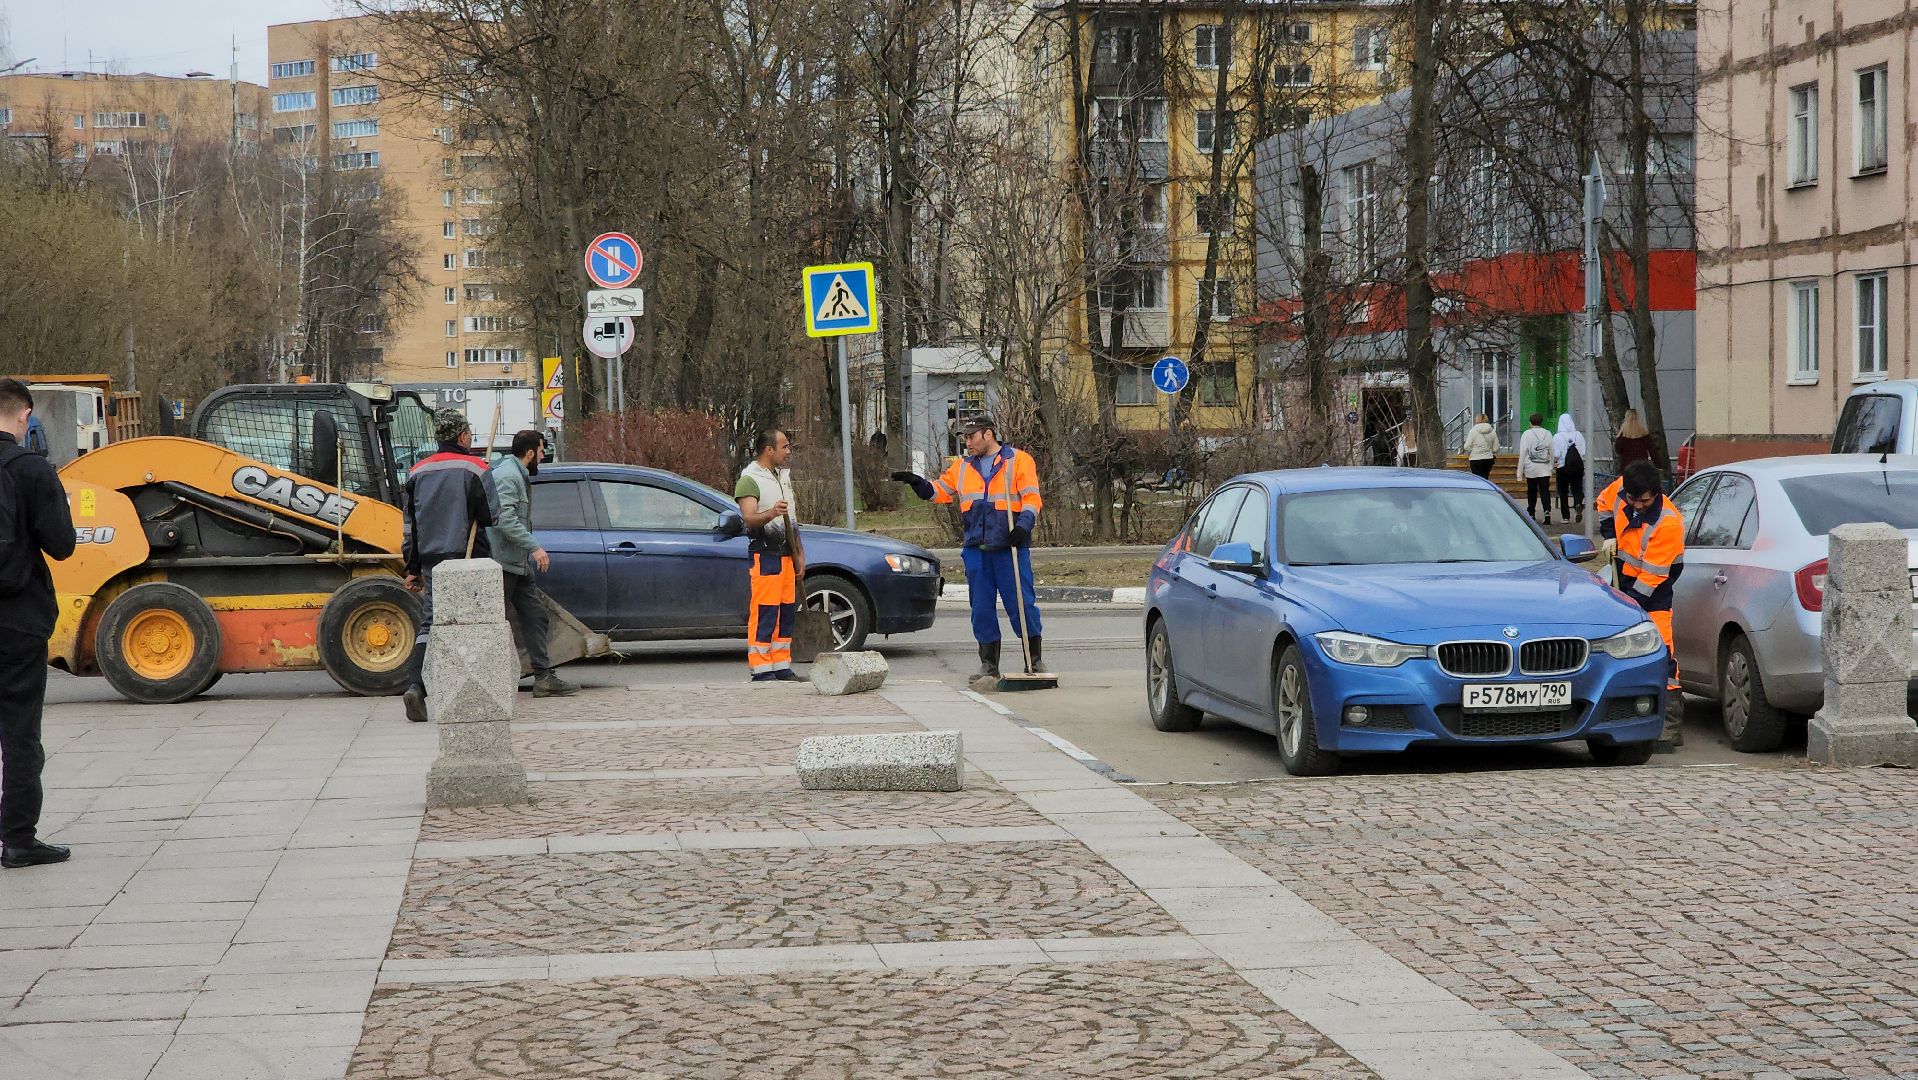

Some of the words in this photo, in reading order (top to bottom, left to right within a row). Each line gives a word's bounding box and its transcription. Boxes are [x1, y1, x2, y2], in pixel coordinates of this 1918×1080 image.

[232, 466, 358, 526] CASE
[1470, 687, 1538, 705] Р578МУ
[1542, 684, 1567, 698] 790
